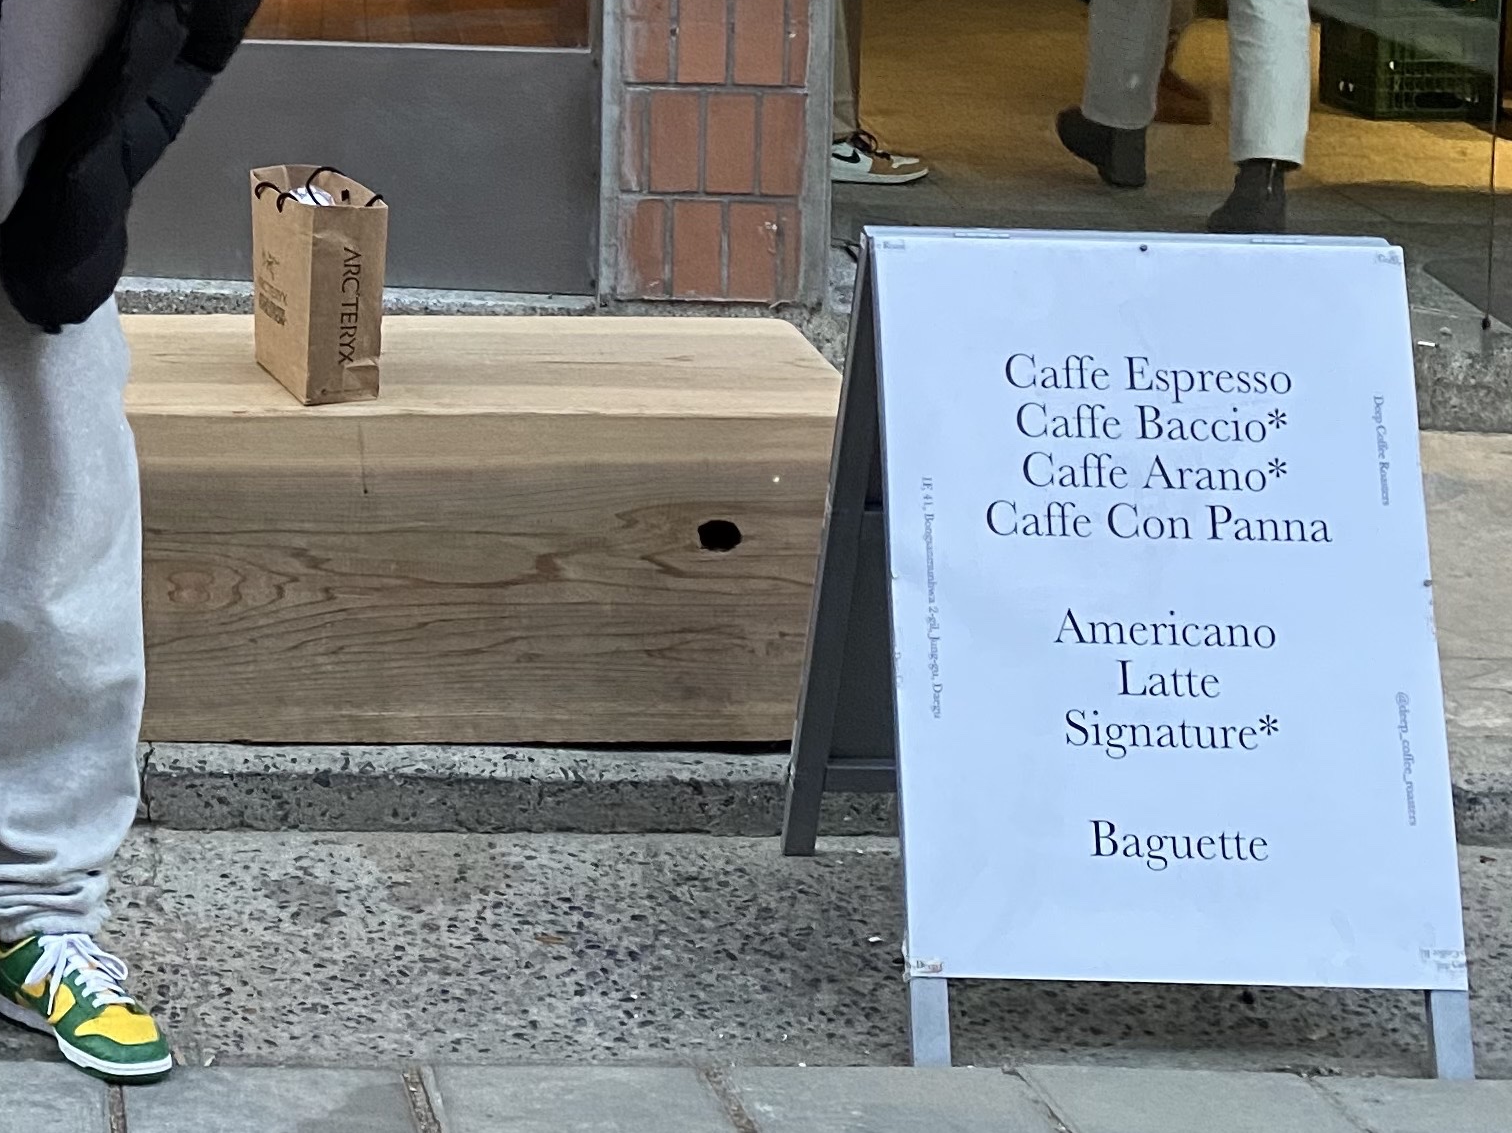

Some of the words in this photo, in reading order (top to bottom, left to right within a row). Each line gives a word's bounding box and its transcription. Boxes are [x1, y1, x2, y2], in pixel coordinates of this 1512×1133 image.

[1005, 353, 1110, 391] Caffe
[1124, 355, 1293, 404] Espresso
[1016, 402, 1122, 440] Caffe
[1022, 451, 1129, 490] Caffe
[986, 499, 1092, 538] Caffe
[1107, 502, 1193, 540] Con
[1204, 504, 1334, 543] Panna
[1053, 608, 1277, 649] Americano
[1116, 659, 1222, 699] Latte
[1088, 819, 1270, 872] Baguette
